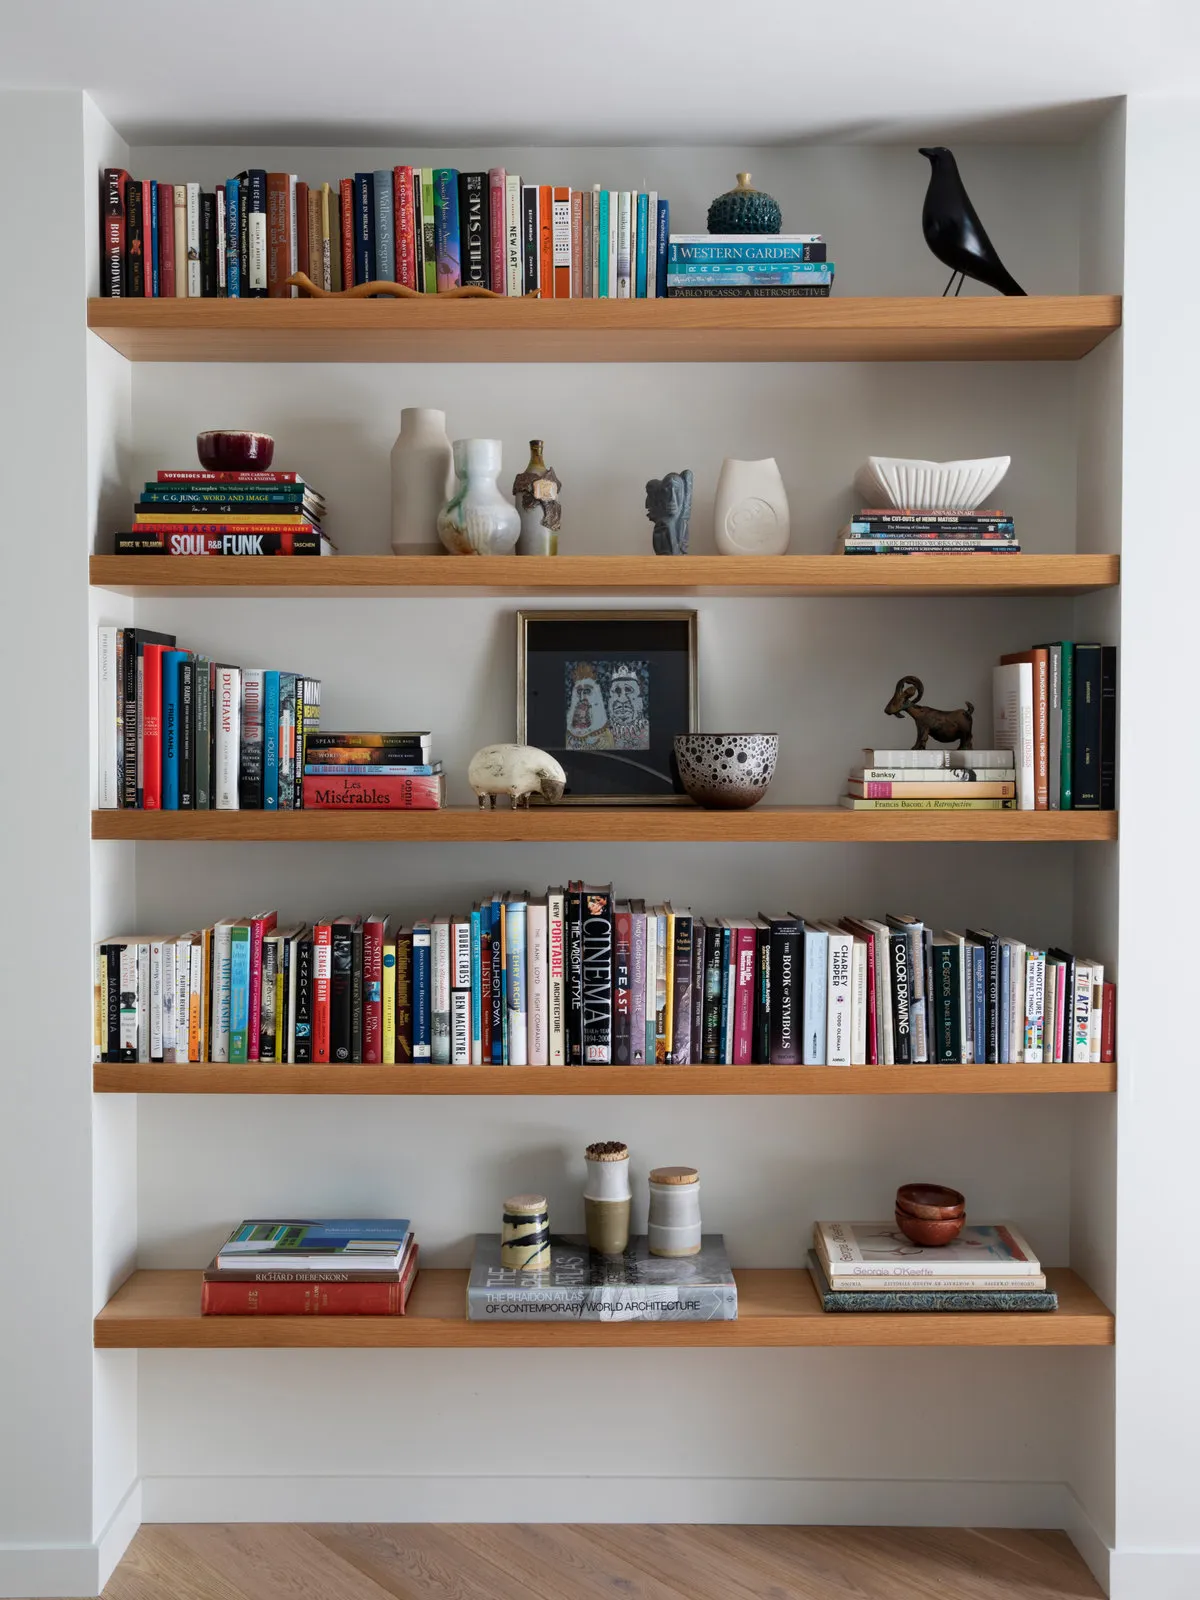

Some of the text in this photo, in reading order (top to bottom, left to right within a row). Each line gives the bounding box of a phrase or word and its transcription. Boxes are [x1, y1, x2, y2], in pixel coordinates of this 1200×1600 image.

[110, 174, 118, 204] FEAR
[111, 224, 119, 243] BOB
[379, 191, 389, 274] Wallace Stegner
[469, 192, 481, 280] CHILD STAR
[681, 248, 800, 258] WESTERN GARDEN
[171, 535, 264, 555] SOUL R&B FUNK
[222, 674, 231, 732] DUCHAMP
[245, 682, 259, 738] BLOODLANDS
[315, 790, 390, 804] Misérables
[344, 780, 361, 789] Les
[552, 920, 562, 977] PORTABLE
[634, 920, 642, 938] Andy
[318, 931, 327, 1002] THE TEENAGE BRAIN
[364, 935, 372, 978] AMERICA
[459, 929, 469, 984] DOUBLE CROSS
[492, 942, 500, 997] LIGHTING
[571, 920, 581, 1010] THE WRIGHT STYLE
[583, 918, 611, 1026] CINEMA
[634, 939, 643, 984] Goldsworthy
[714, 971, 720, 981] ON
[783, 955, 791, 986] BOOK
[832, 952, 840, 986] HARPER
[840, 945, 848, 986] CHARLEY
[976, 960, 984, 981] tonight
[265, 987, 273, 1008] every
[482, 961, 490, 998] LISTEN
[618, 966, 627, 1014] FEAST
[895, 944, 909, 1034] COLOR DRAWING
[109, 977, 117, 1033] MAGONIA
[265, 1009, 273, 1021] day
[455, 995, 466, 1055] BEN MACINTYRE
[782, 997, 791, 1048] SYMBOLS
[1076, 973, 1089, 1045] THE ART BOOK
[588, 1047, 604, 1058] DK
[486, 1292, 584, 1302] THE PHAIDON ATLAS
[486, 1301, 701, 1313] OF CONTEMPORARY WORLD ARCHITECTURE
